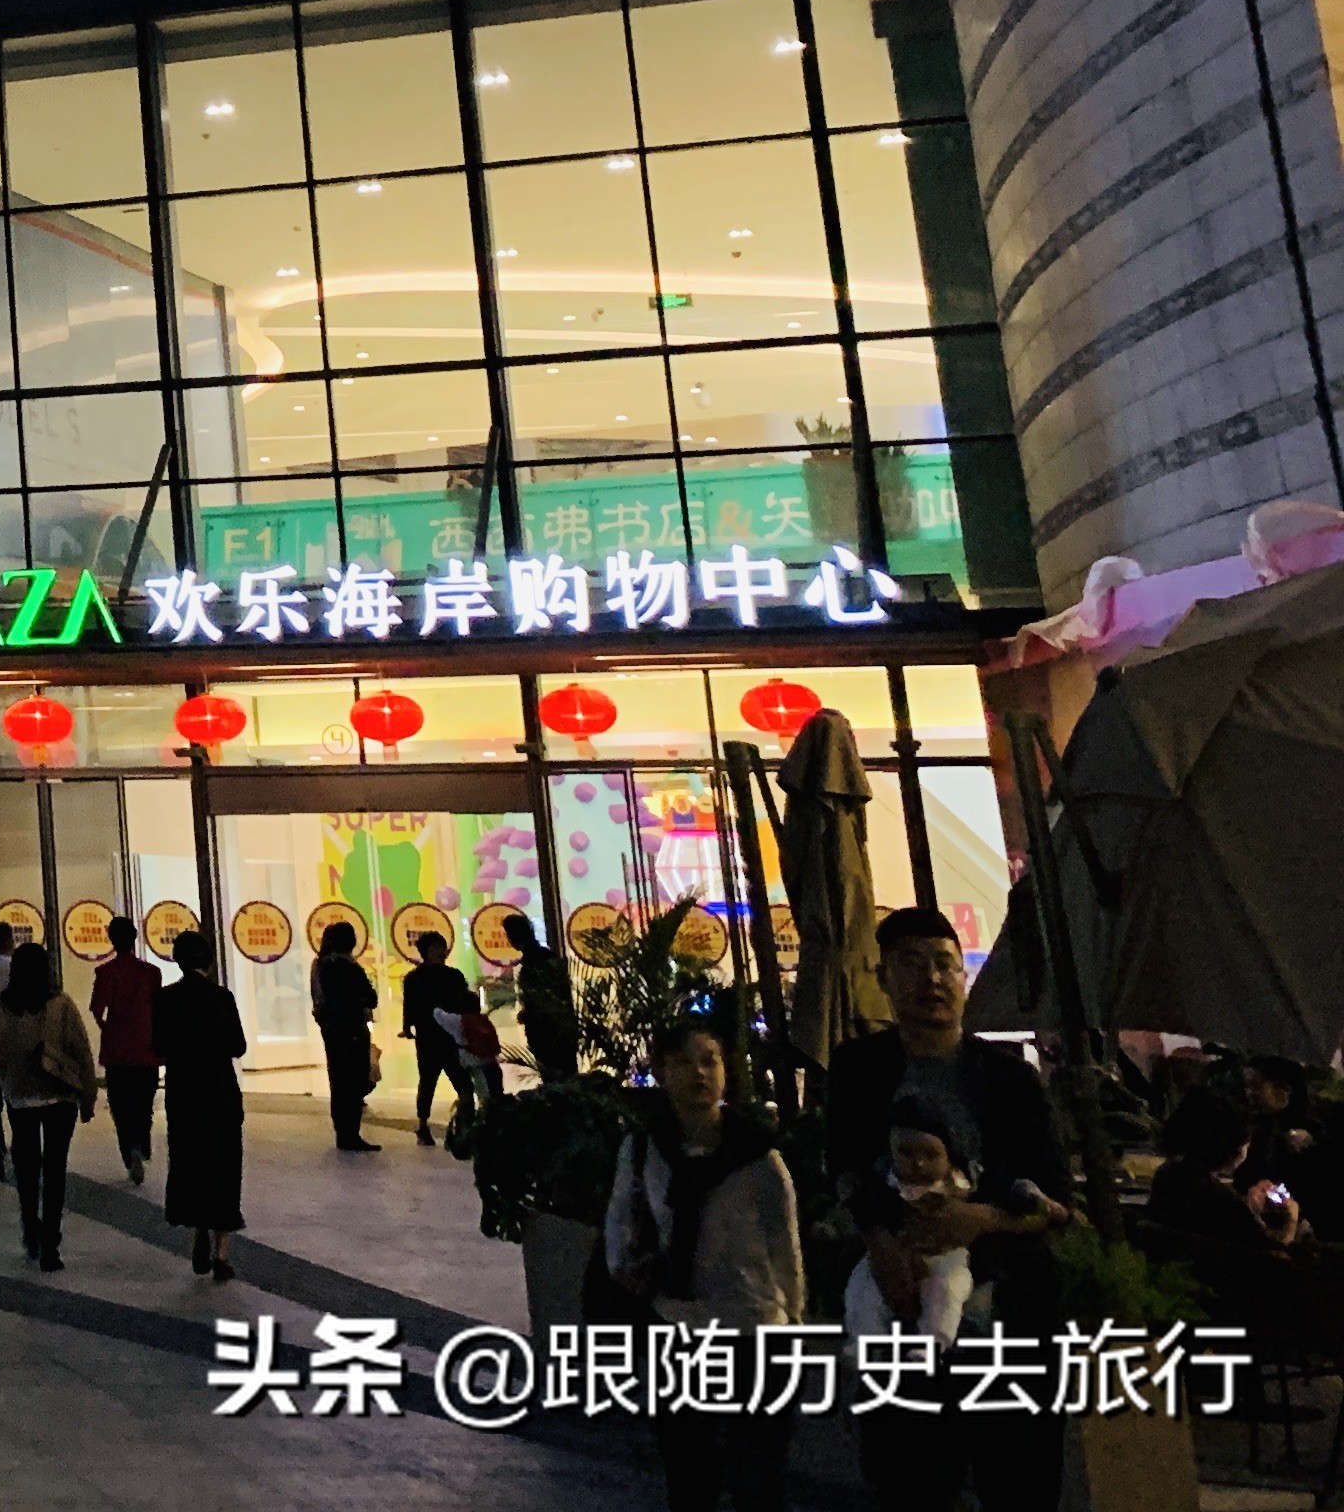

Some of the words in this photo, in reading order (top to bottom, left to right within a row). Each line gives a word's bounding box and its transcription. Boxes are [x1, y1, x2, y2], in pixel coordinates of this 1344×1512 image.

[223, 526, 272, 564] F1
[145, 544, 901, 643] 欢乐海岸购物中心
